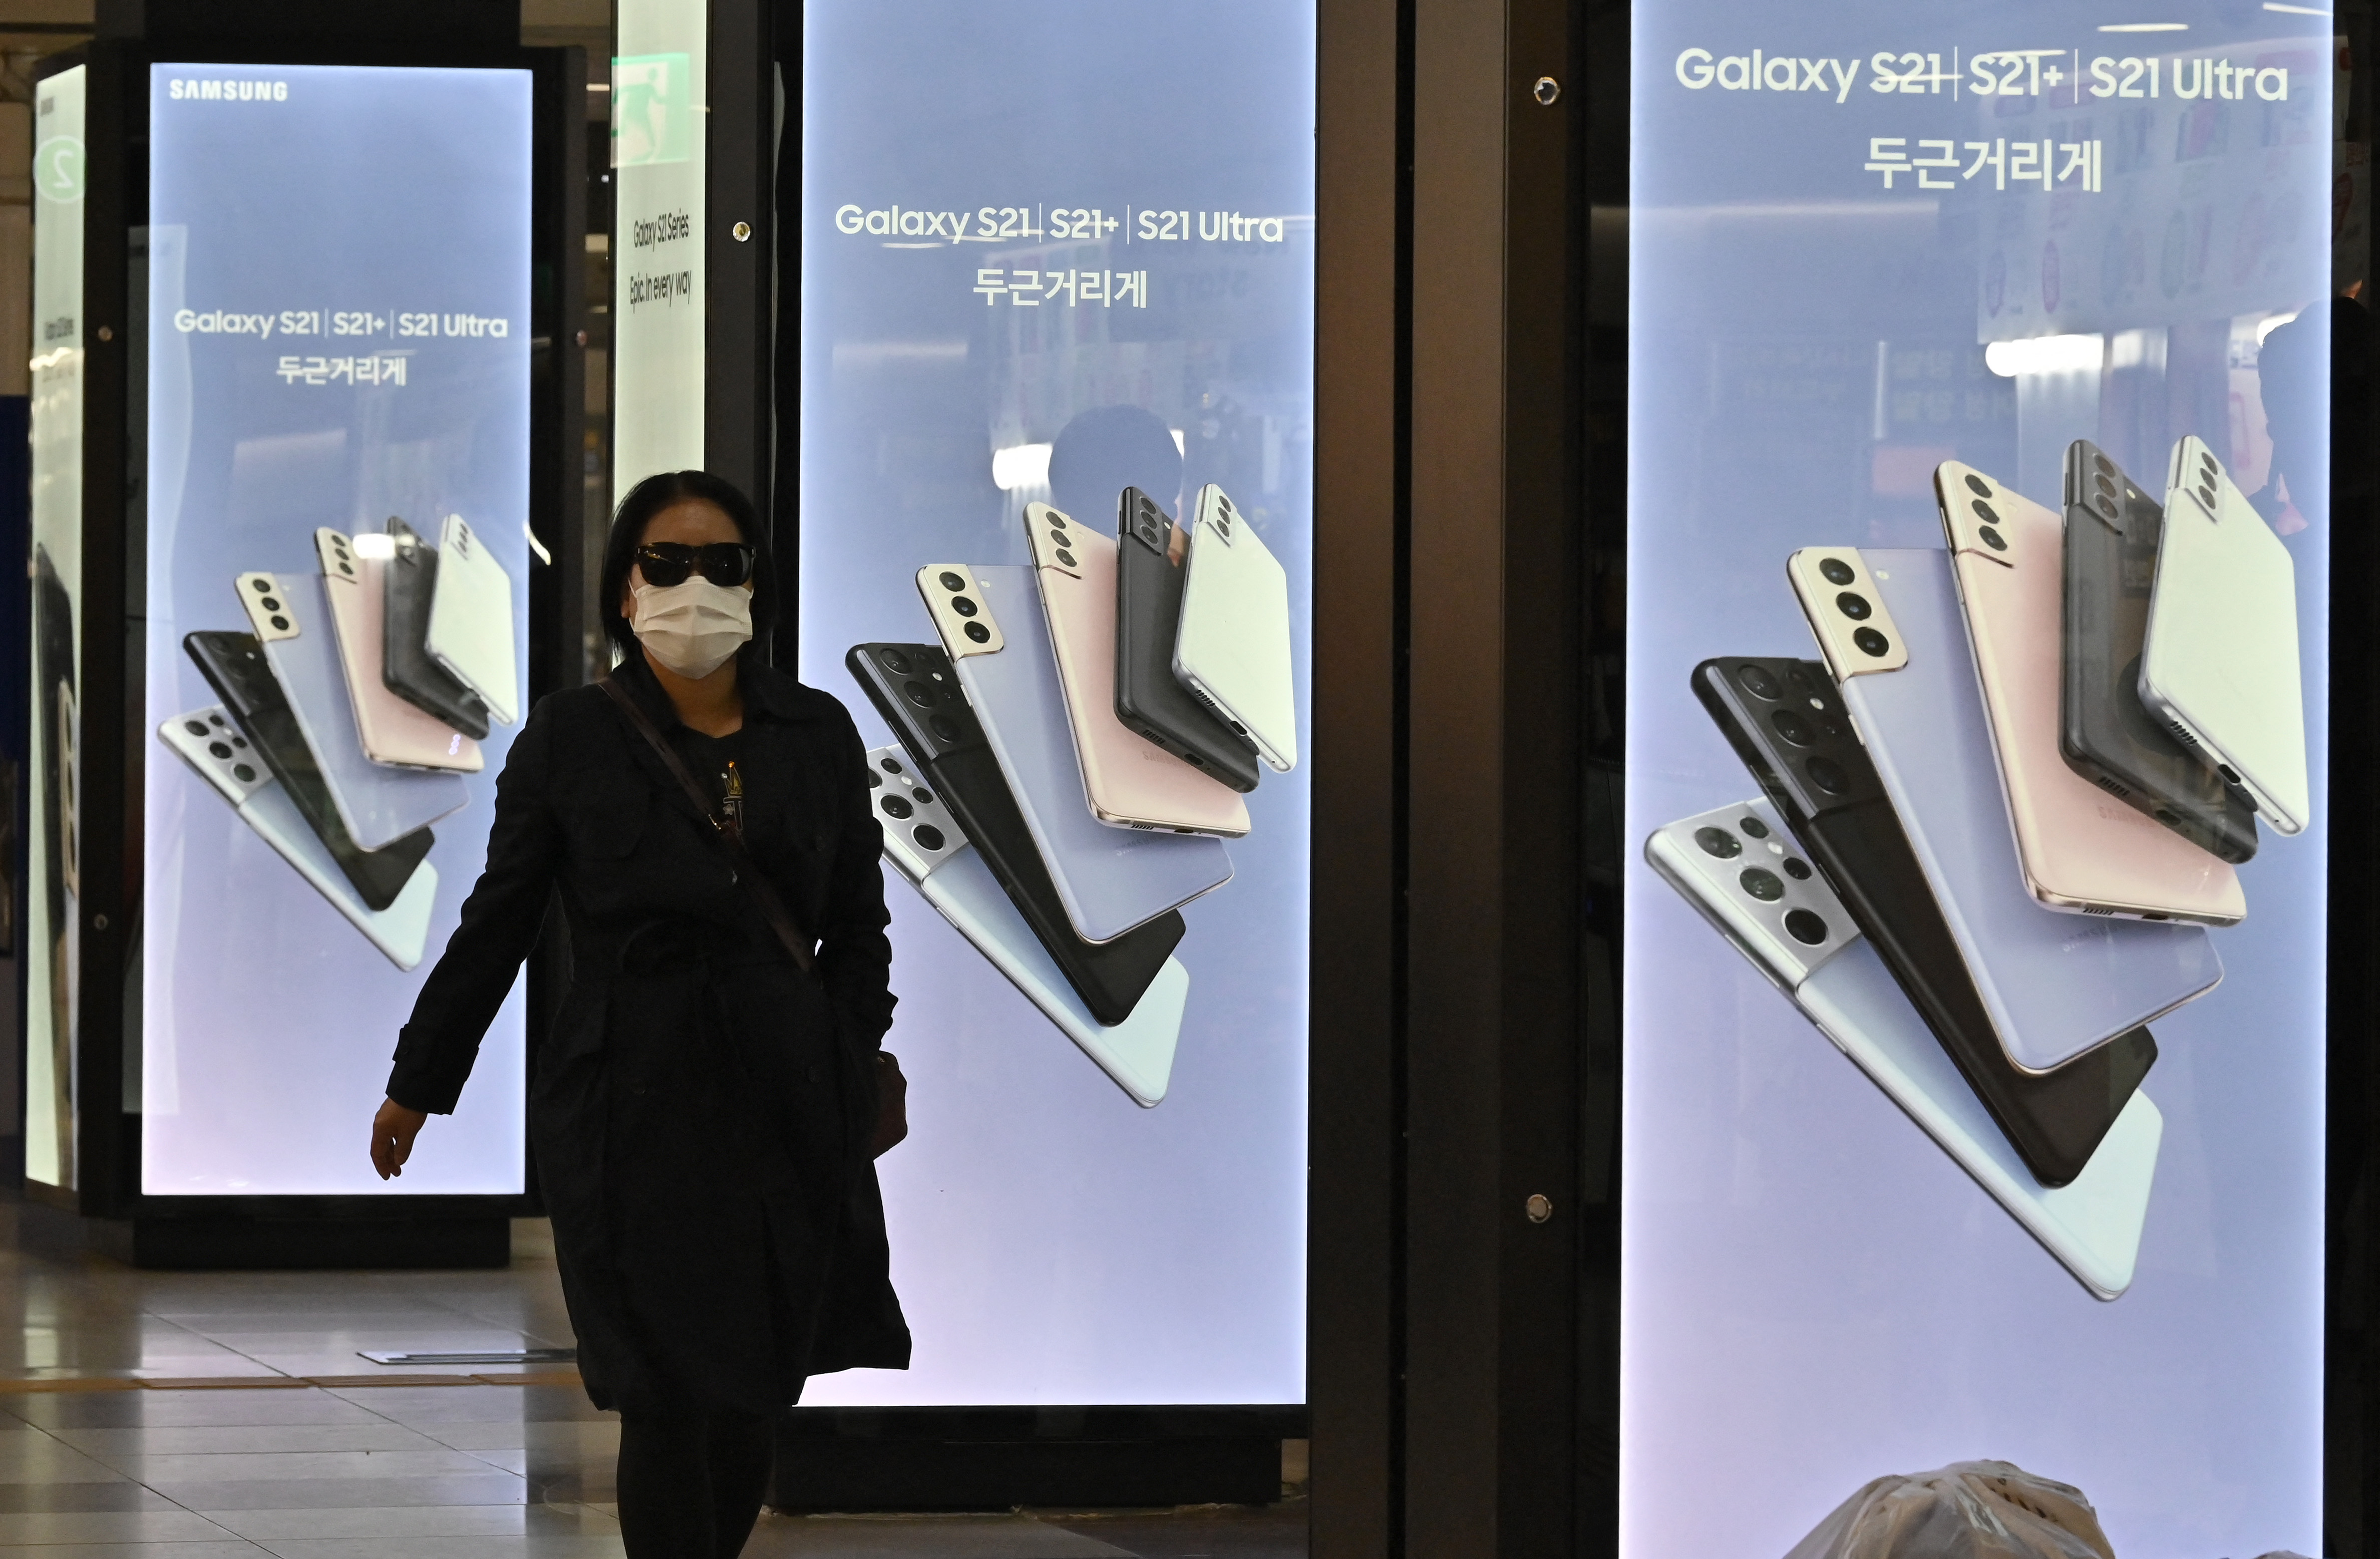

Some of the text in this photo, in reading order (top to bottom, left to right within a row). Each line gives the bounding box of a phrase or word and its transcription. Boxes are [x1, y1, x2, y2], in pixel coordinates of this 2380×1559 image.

[170, 79, 288, 102] SAMSUNG
[1675, 48, 2288, 103] Galaxy S21 S21+ S21 Ultra
[1864, 138, 2102, 193] 두근거리게
[634, 207, 689, 252] Galaxy S21 Series
[835, 205, 1284, 244] Galaxy S21 S21+ S21 Ultra
[630, 270, 692, 314] Epic. In every way
[973, 269, 1148, 308] 두근거리게
[174, 308, 509, 340] Galaxy S21 S21+ S21 Ultra
[276, 356, 408, 387] 두근거리게
